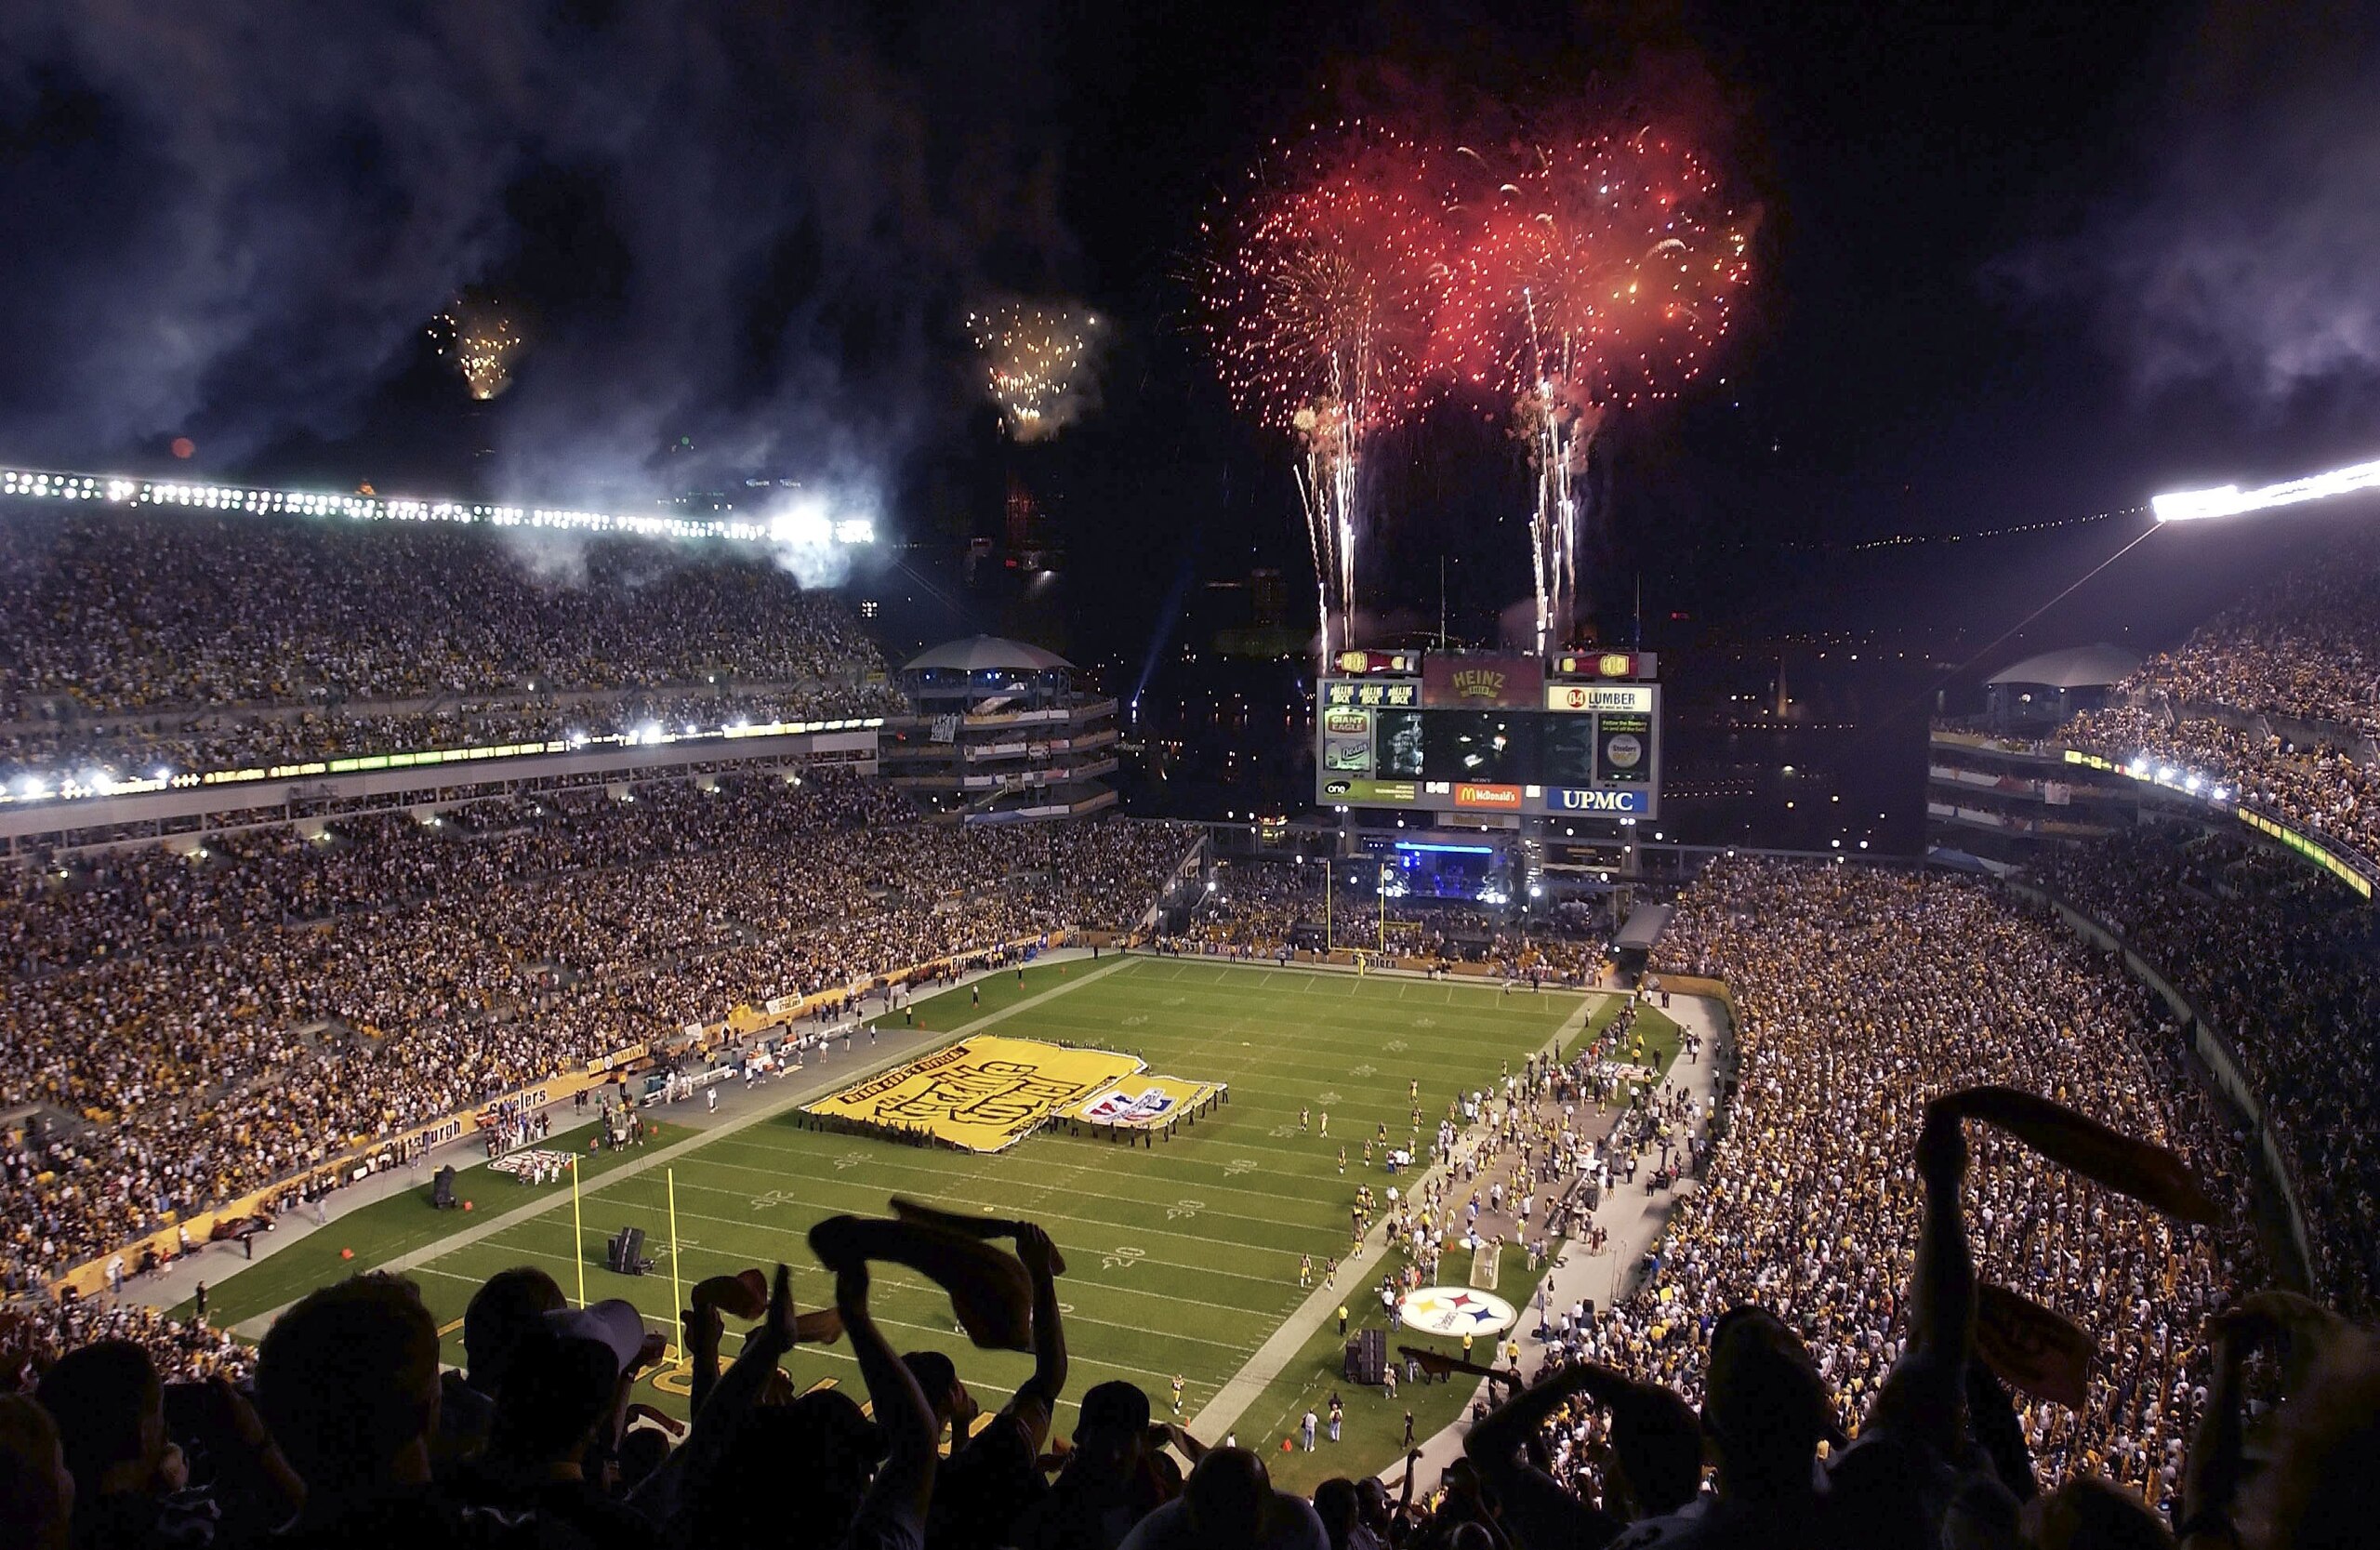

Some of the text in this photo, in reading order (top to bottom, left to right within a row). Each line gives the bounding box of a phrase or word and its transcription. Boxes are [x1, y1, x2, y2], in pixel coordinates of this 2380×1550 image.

[1453, 669, 1506, 688] HEINZ
[1588, 693, 1635, 705] LUMBER
[1330, 716, 1364, 724] GIANT
[1331, 723, 1363, 732] EAGLE
[1475, 790, 1516, 801] McDonald's
[1562, 789, 1633, 812] UPMC
[1102, 1247, 1145, 1268] 20
